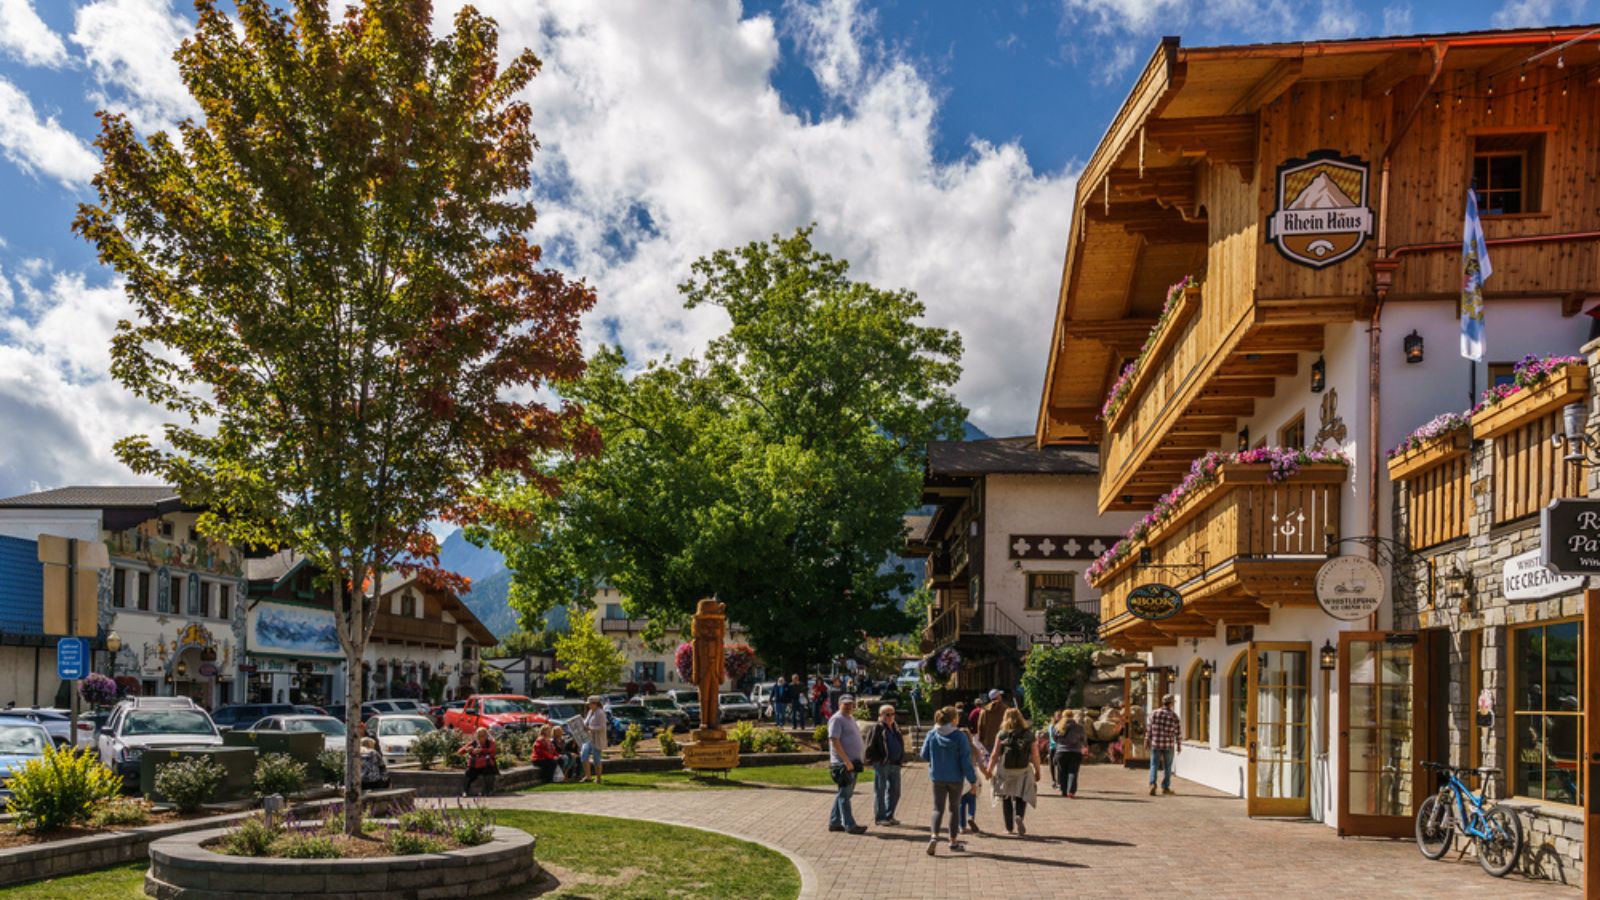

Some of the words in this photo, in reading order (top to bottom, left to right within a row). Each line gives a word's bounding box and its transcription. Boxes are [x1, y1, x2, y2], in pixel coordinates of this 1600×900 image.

[1284, 213, 1323, 230] Rhein
[1577, 511, 1600, 529] R
[1568, 533, 1600, 552] Pa
[1505, 575, 1520, 592] ICE
